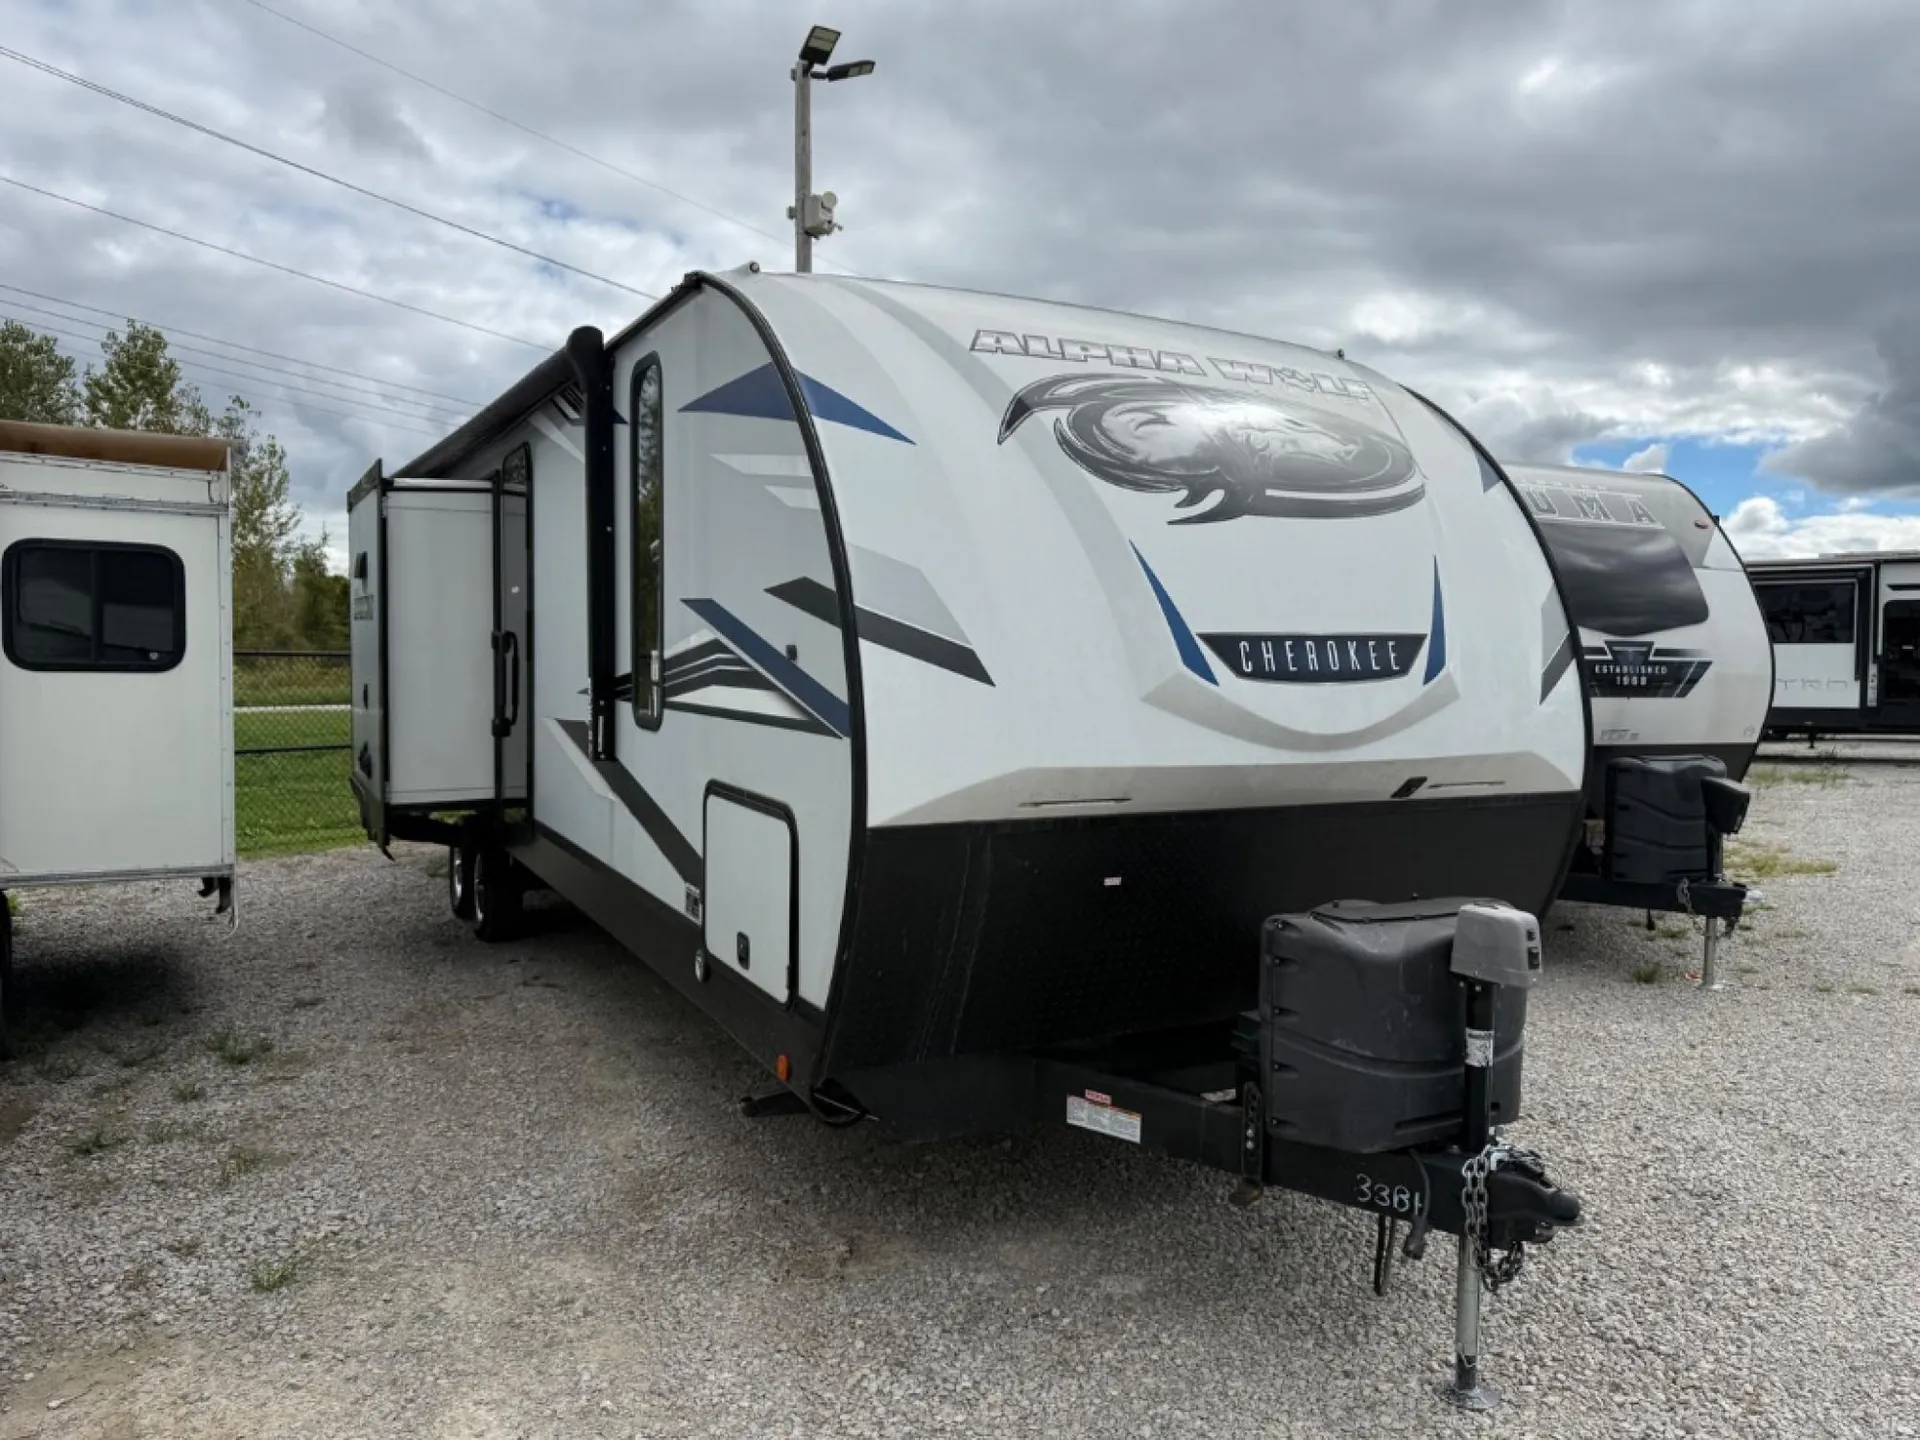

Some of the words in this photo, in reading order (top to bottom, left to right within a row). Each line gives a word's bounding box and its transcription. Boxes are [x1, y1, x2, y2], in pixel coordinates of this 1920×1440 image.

[970, 329, 1208, 377] ALPHA
[1206, 356, 1371, 401] WOLF
[1521, 486, 1664, 526] UMA
[1239, 640, 1401, 672] CHEROKEE
[1594, 664, 1668, 675] ESTABLISHED
